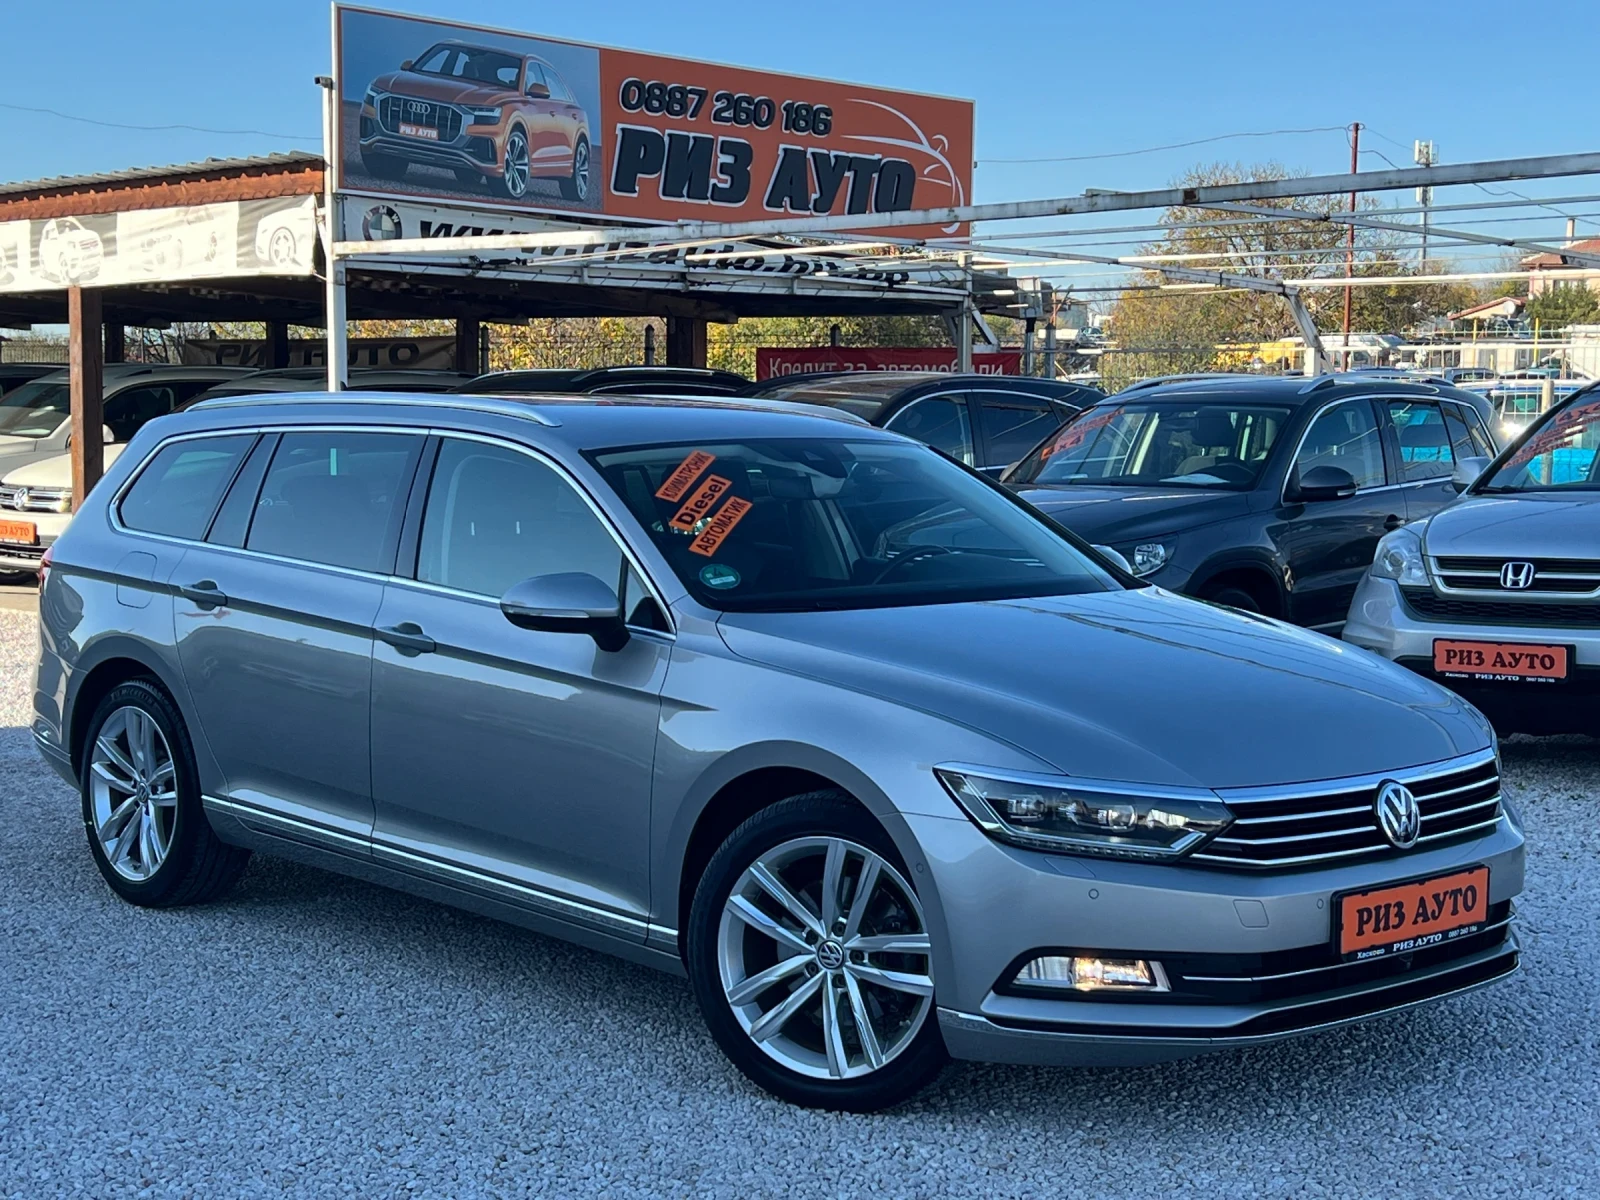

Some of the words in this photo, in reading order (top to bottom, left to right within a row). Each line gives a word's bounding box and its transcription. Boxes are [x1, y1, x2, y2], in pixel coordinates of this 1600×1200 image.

[620, 77, 708, 121] 0887
[711, 90, 776, 131] 260
[781, 99, 833, 138] 186
[610, 123, 753, 207] РИЗ
[763, 144, 916, 216] АУТО
[303, 342, 420, 366] ATO
[661, 451, 711, 499] КЛИМАТРОНИК
[676, 478, 727, 526] Diesel
[696, 498, 748, 553] АВТОМАТИК
[1445, 649, 1485, 667] РИЗ
[1491, 651, 1556, 671] АУТО
[1494, 674, 1520, 682] АУТО
[1355, 900, 1406, 937] РИЗ
[1411, 884, 1477, 926] АУТО
[1392, 939, 1414, 952] РИЗ
[1414, 933, 1443, 947] АУТО
